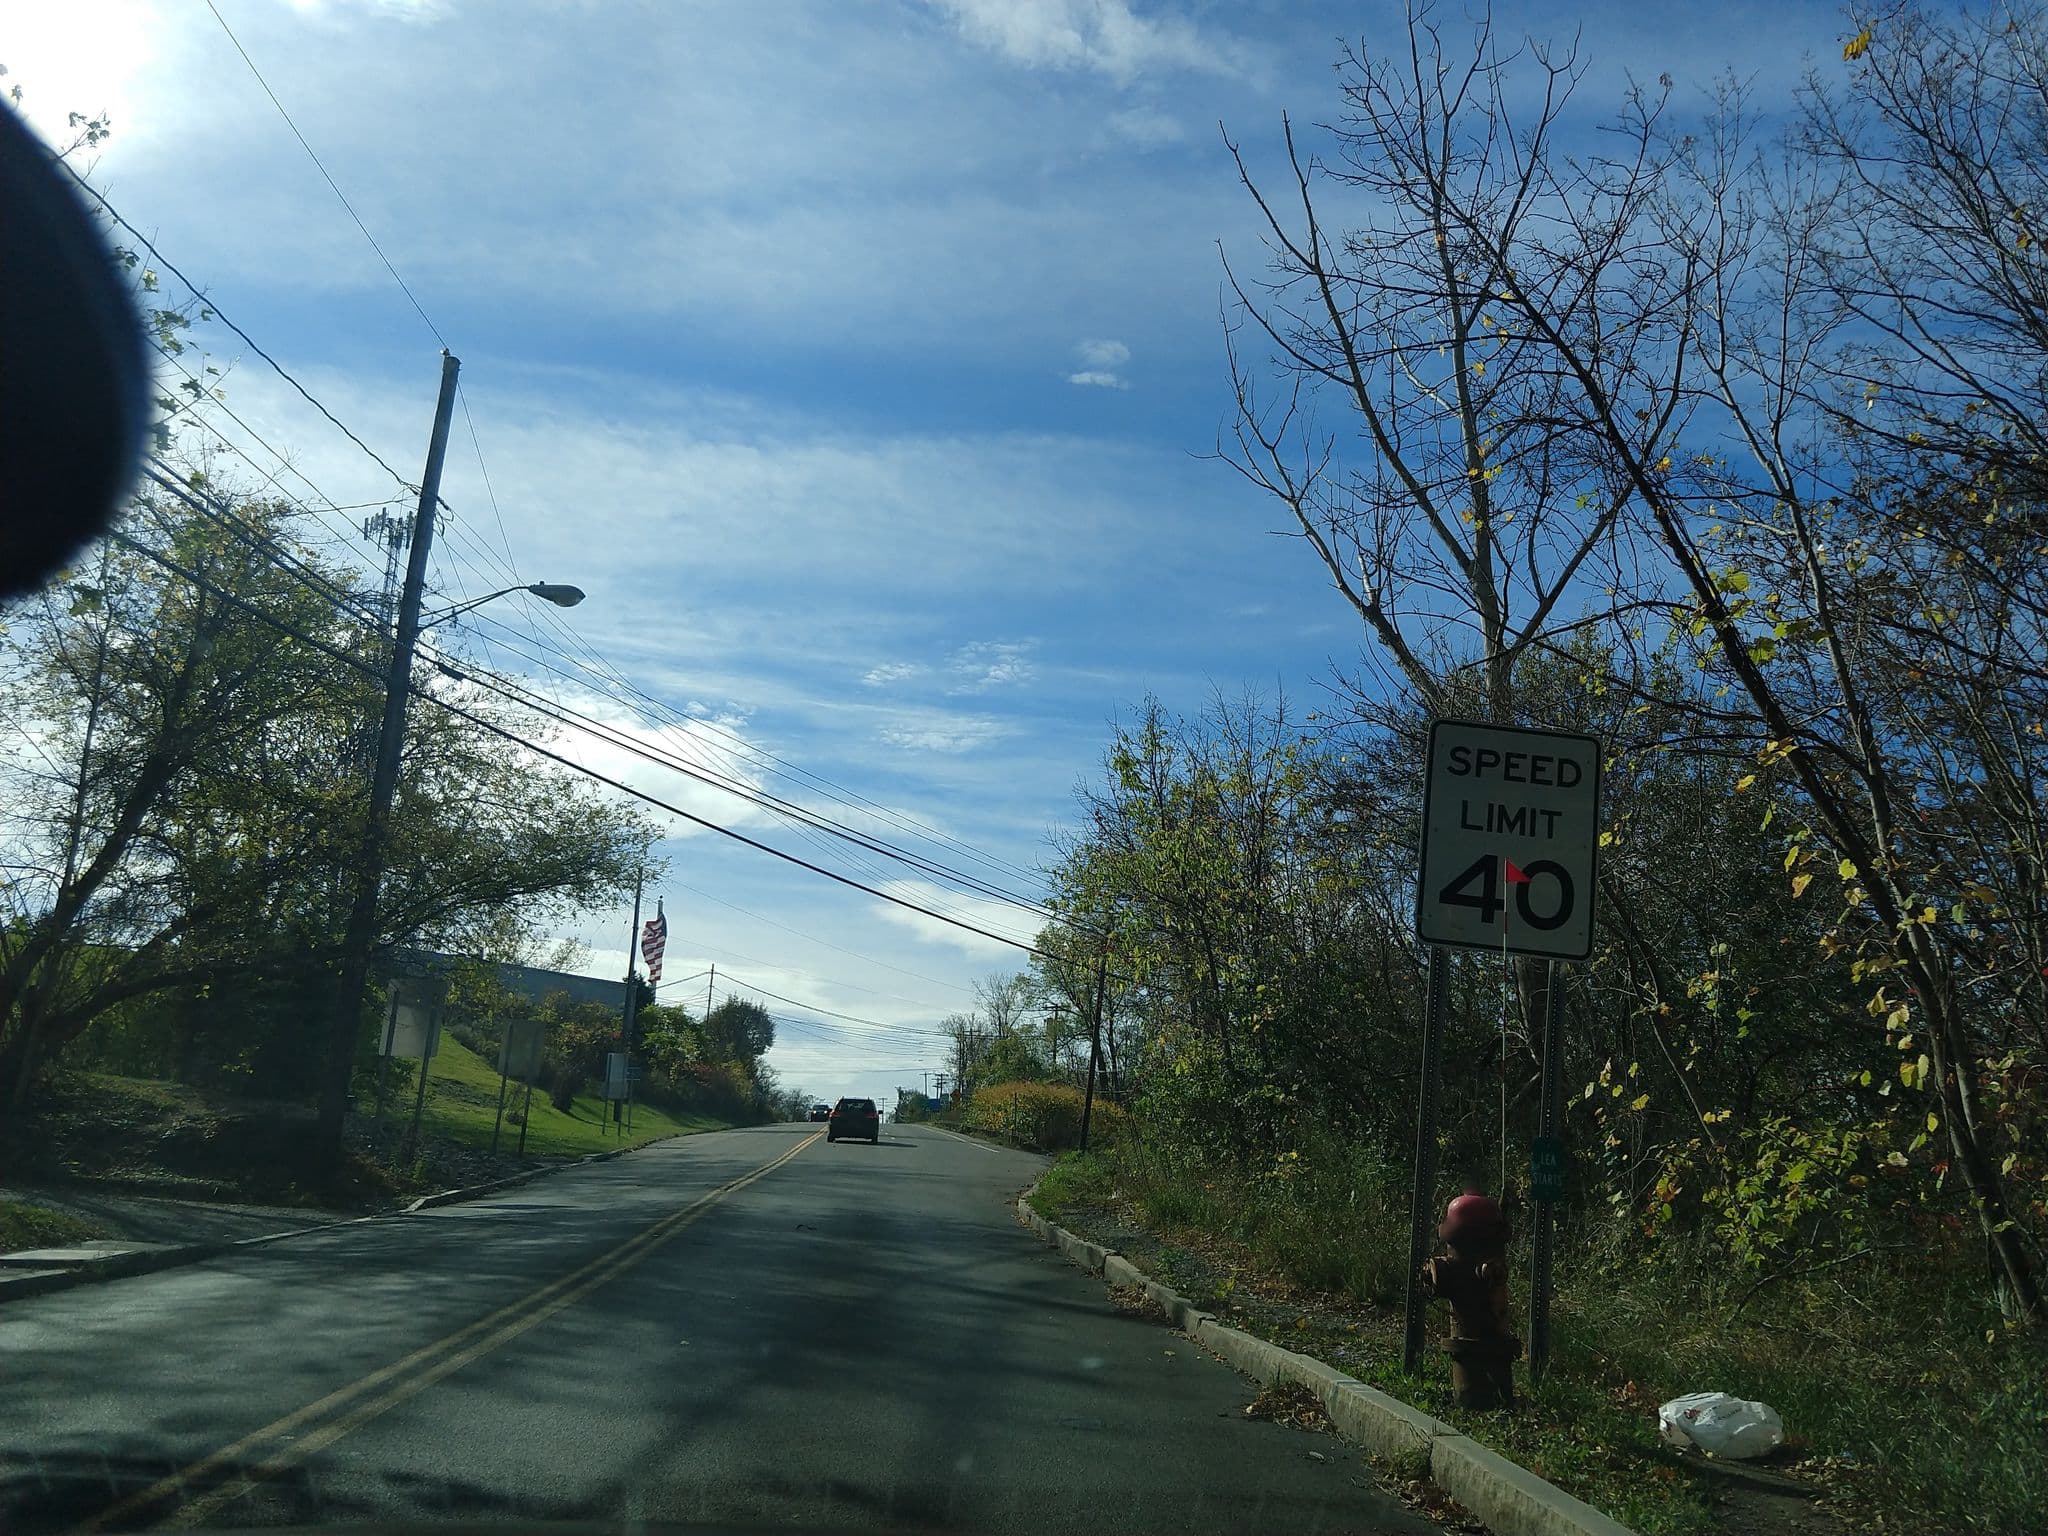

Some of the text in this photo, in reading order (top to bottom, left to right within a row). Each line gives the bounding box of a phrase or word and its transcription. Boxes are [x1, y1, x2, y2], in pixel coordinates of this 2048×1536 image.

[1447, 746, 1582, 788] SPEED
[1461, 800, 1562, 839] LIMIT
[1439, 854, 1575, 931] 40
